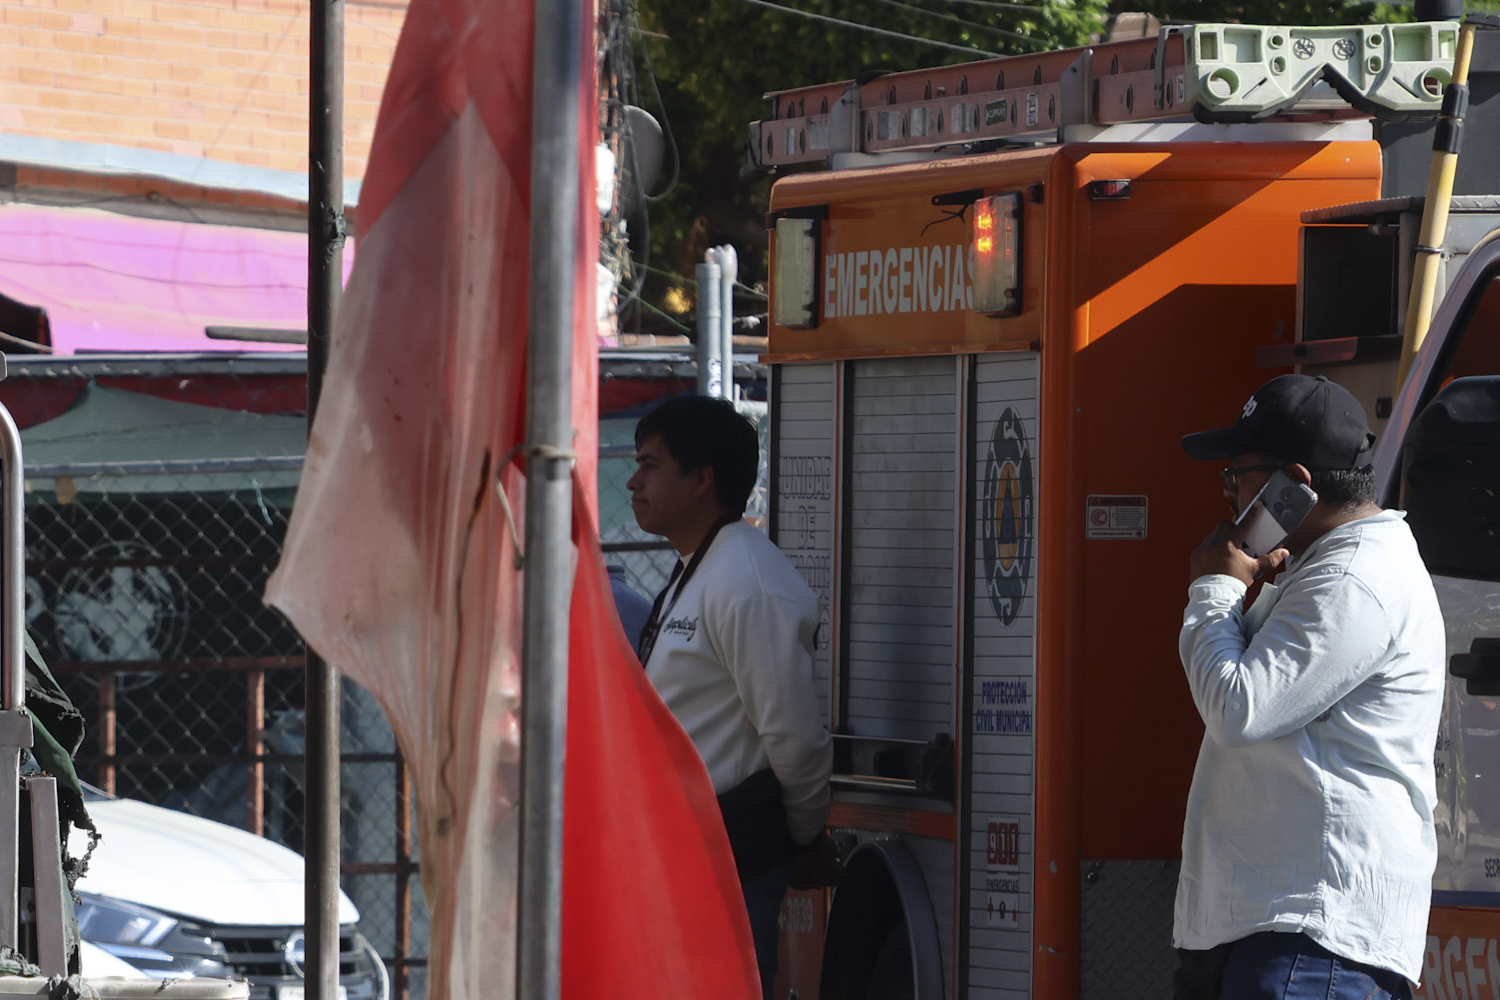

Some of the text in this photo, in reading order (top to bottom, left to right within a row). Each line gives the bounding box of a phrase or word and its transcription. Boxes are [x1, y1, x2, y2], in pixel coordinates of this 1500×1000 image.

[982, 676, 1027, 704] PROTECCIÓN
[976, 708, 995, 733] CIVIL
[988, 828, 1017, 860] 911
